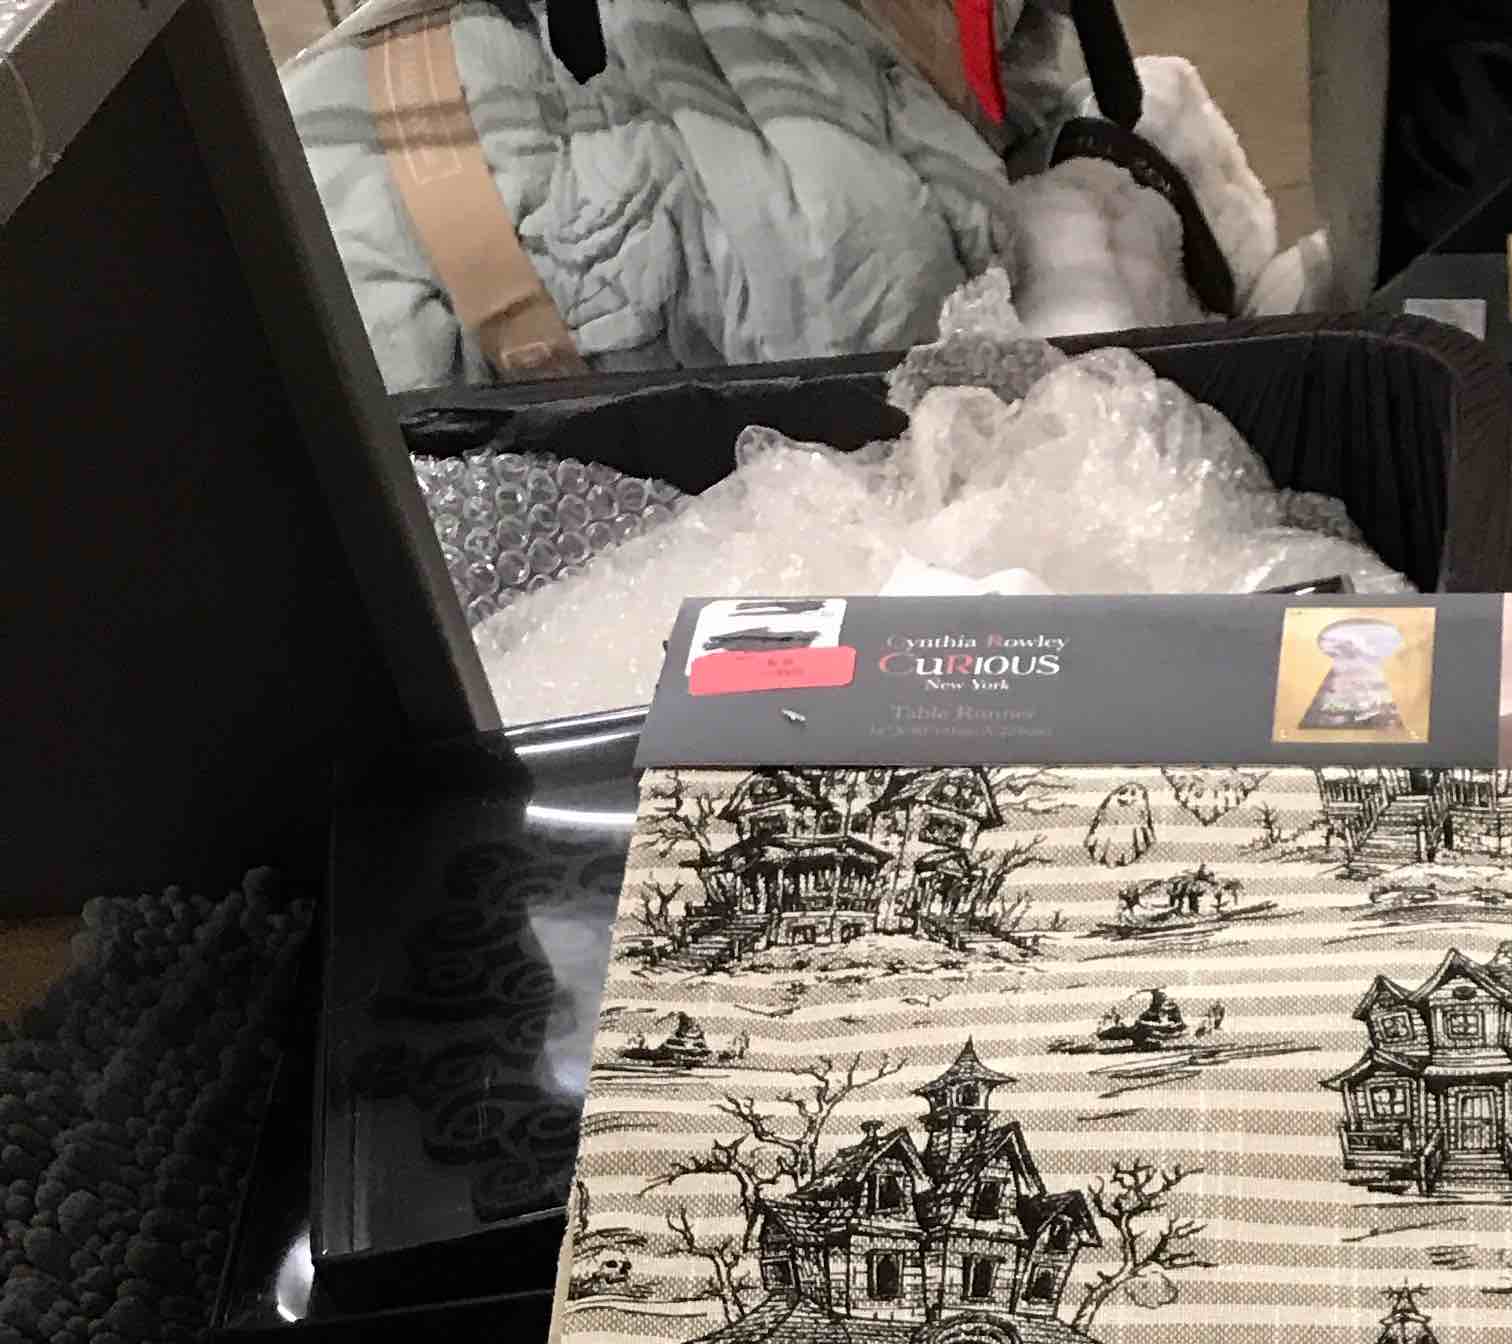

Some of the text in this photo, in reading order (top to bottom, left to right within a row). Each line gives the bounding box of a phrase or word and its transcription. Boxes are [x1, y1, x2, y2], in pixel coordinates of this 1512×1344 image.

[886, 634, 1069, 652] Cynthia Rowley
[926, 677, 1009, 691] New York
